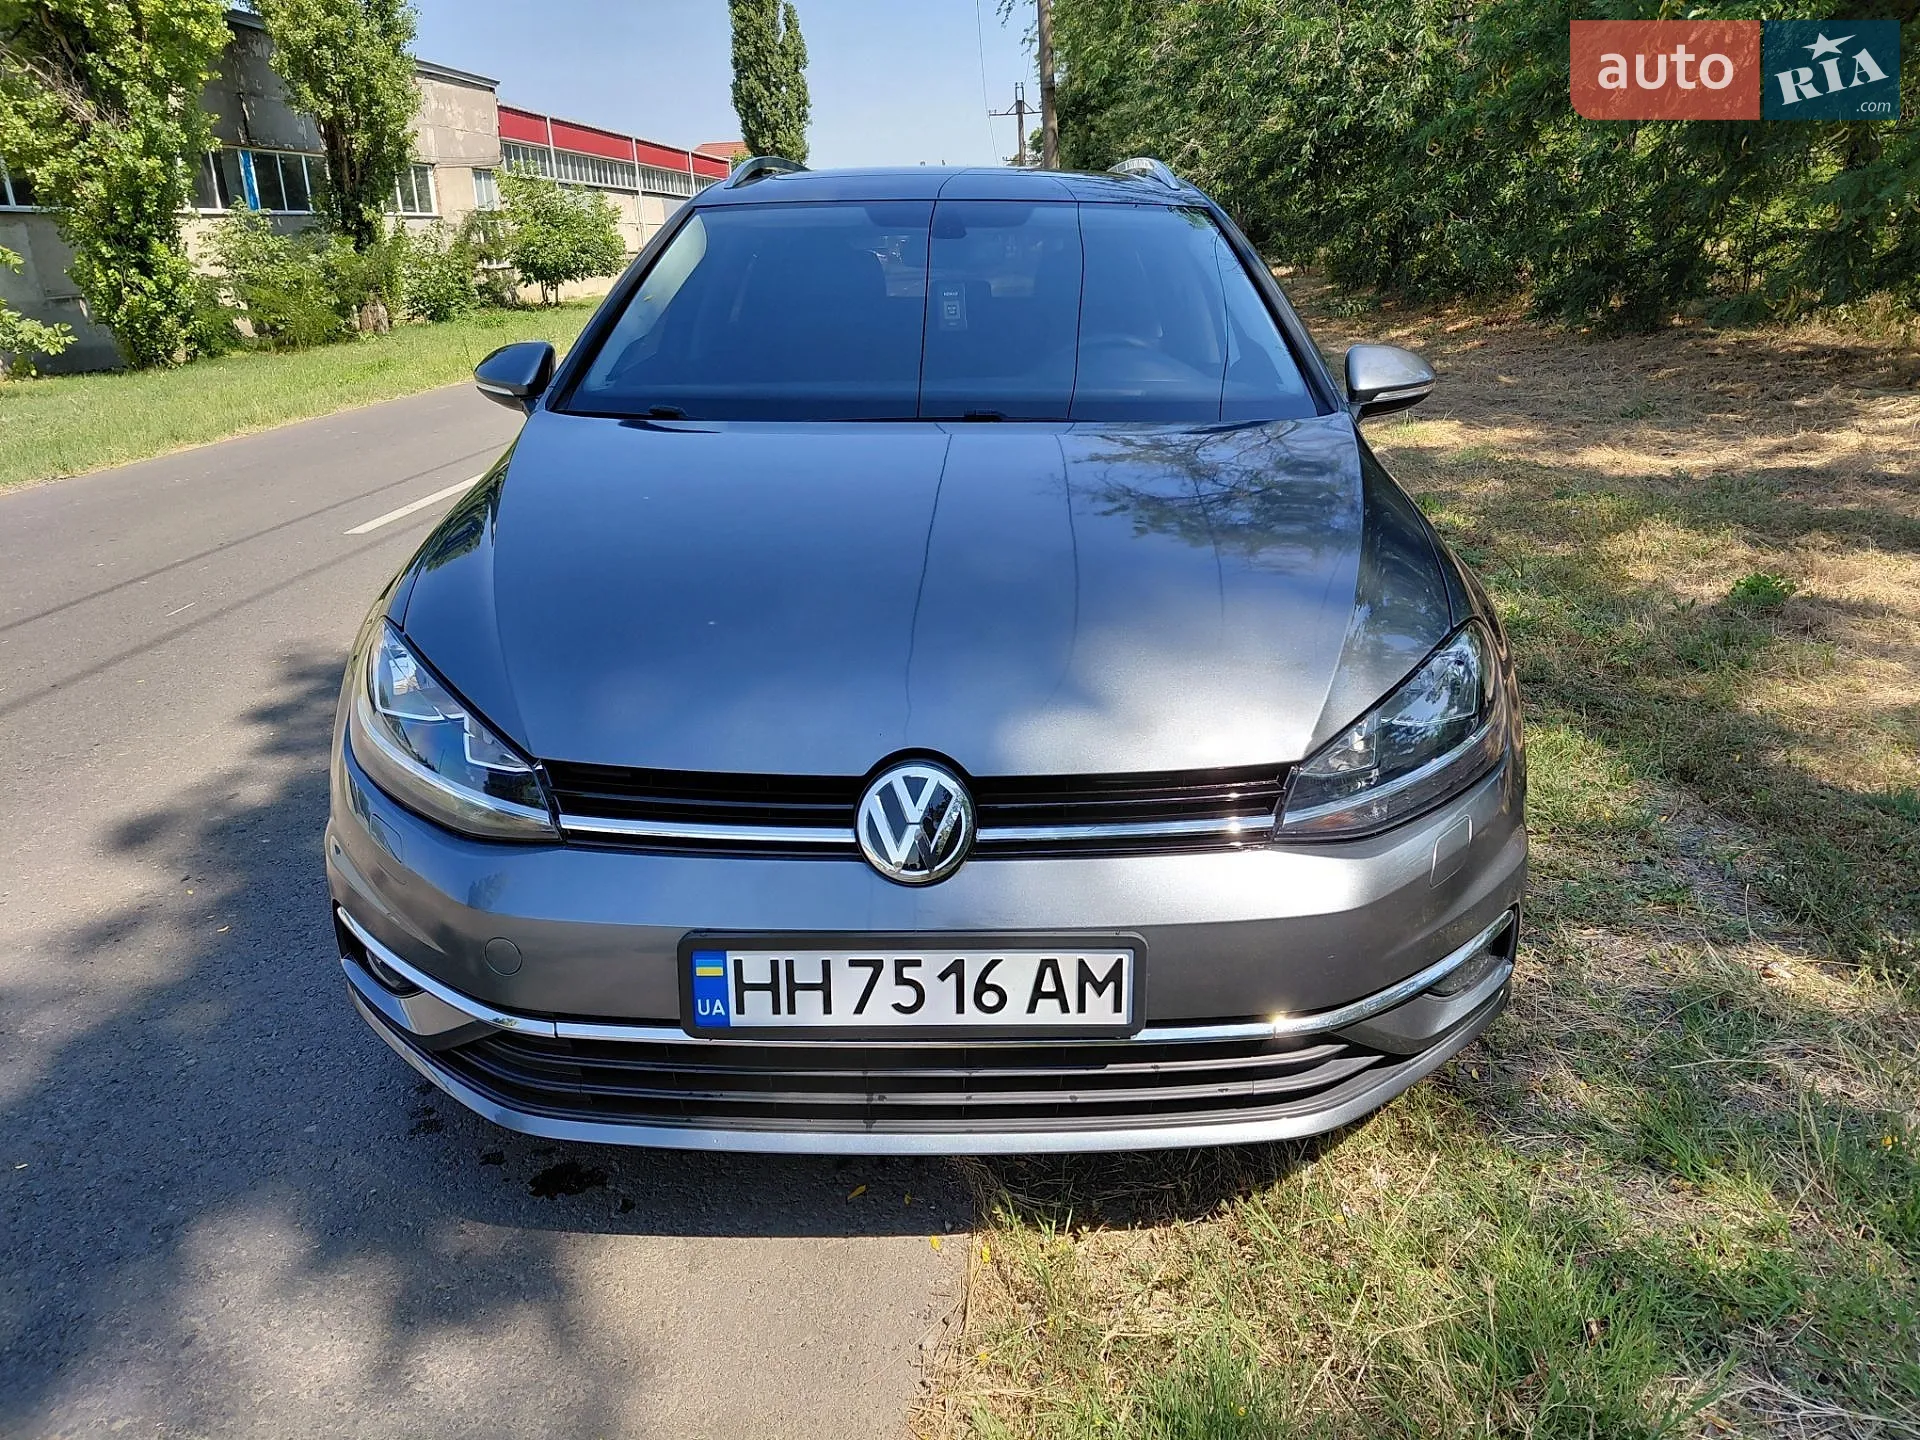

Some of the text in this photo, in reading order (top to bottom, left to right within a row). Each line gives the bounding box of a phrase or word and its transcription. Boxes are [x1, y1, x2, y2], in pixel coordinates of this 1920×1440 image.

[865, 772, 964, 876] VW
[697, 999, 726, 1016] UA
[732, 957, 1124, 1016] HH 7516 AM
